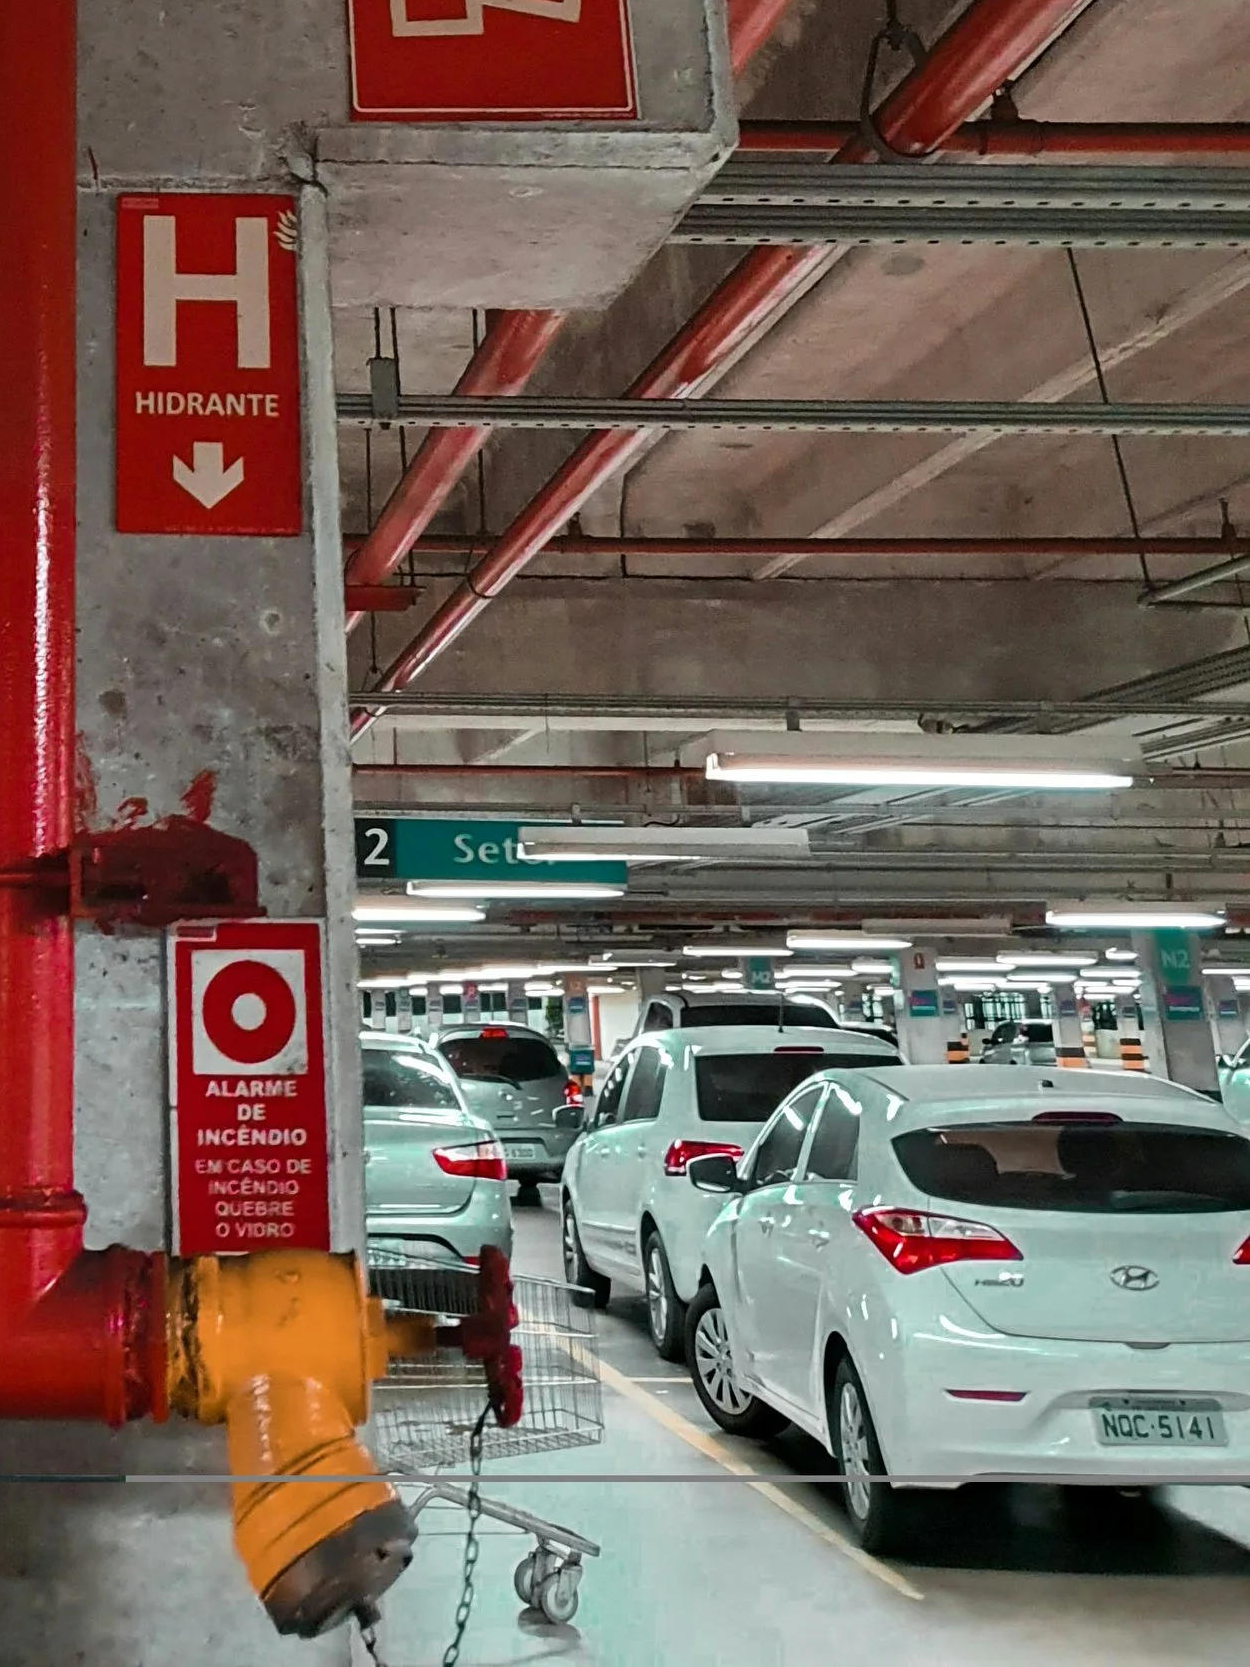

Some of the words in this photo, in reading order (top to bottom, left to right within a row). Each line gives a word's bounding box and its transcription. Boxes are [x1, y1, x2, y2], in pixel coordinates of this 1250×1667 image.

[143, 214, 271, 369] H
[134, 391, 280, 417] HIDRANTE
[363, 827, 390, 866] 2
[453, 833, 557, 866] Set
[204, 1079, 298, 1098] ALARME
[237, 1103, 267, 1122] DE
[197, 1123, 308, 1147] INCÊNDIO
[195, 1158, 222, 1175] EM
[227, 1158, 282, 1175] CASO
[286, 1158, 313, 1175] DE
[208, 1177, 300, 1196] INCÊNDIO
[214, 1200, 295, 1217] QUEBRE
[215, 1221, 230, 1238] O
[235, 1221, 296, 1239] VIDRO
